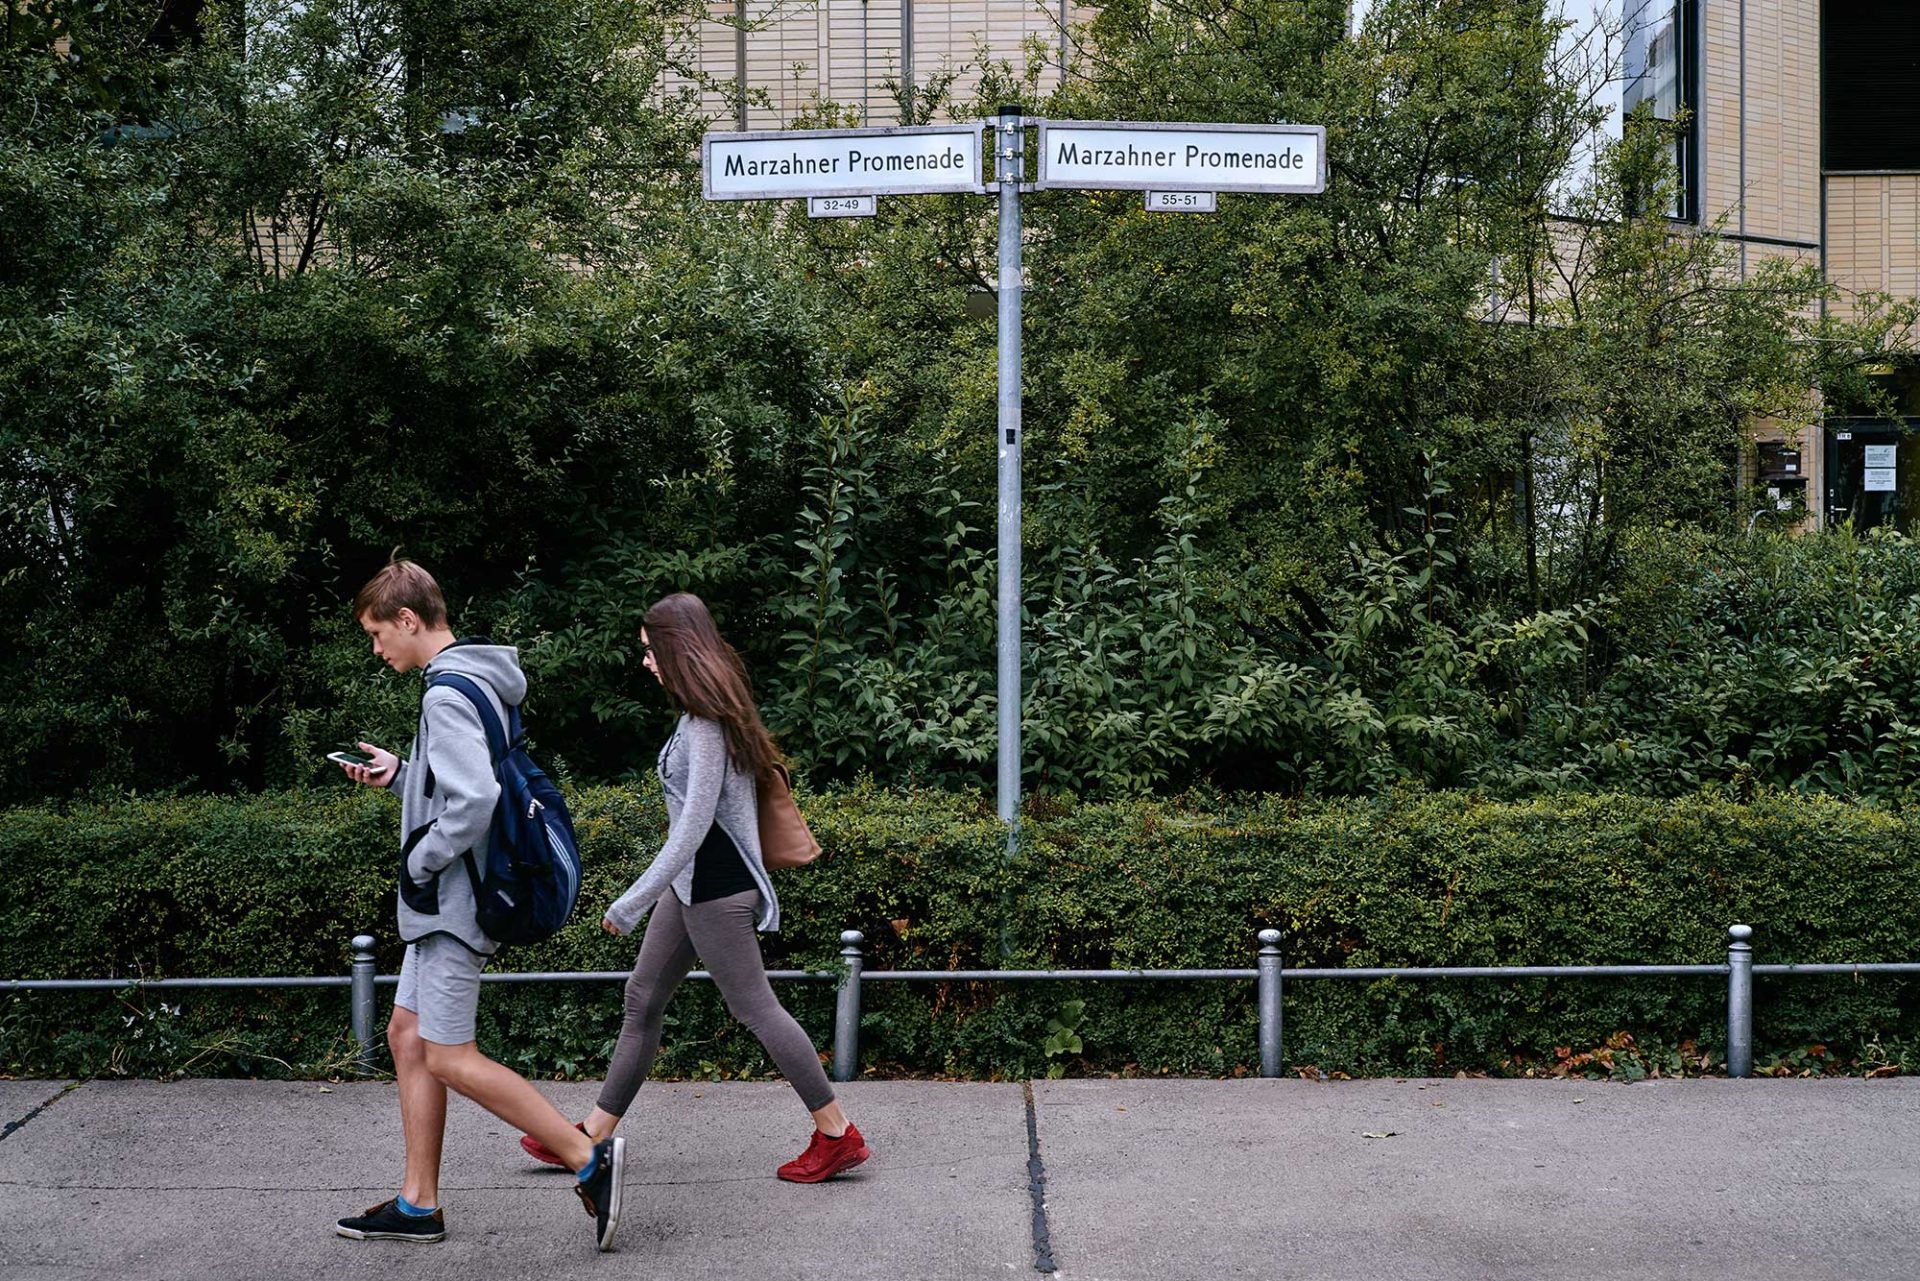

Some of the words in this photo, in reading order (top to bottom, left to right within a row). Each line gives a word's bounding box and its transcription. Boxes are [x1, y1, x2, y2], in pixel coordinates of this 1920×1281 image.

[724, 153, 840, 176] Marzahner
[849, 147, 965, 172] Promenade
[1057, 142, 1176, 167] Marzahner
[1186, 145, 1304, 169] Promenade
[824, 200, 859, 210] 32-49
[1162, 194, 1198, 205] 55-51
